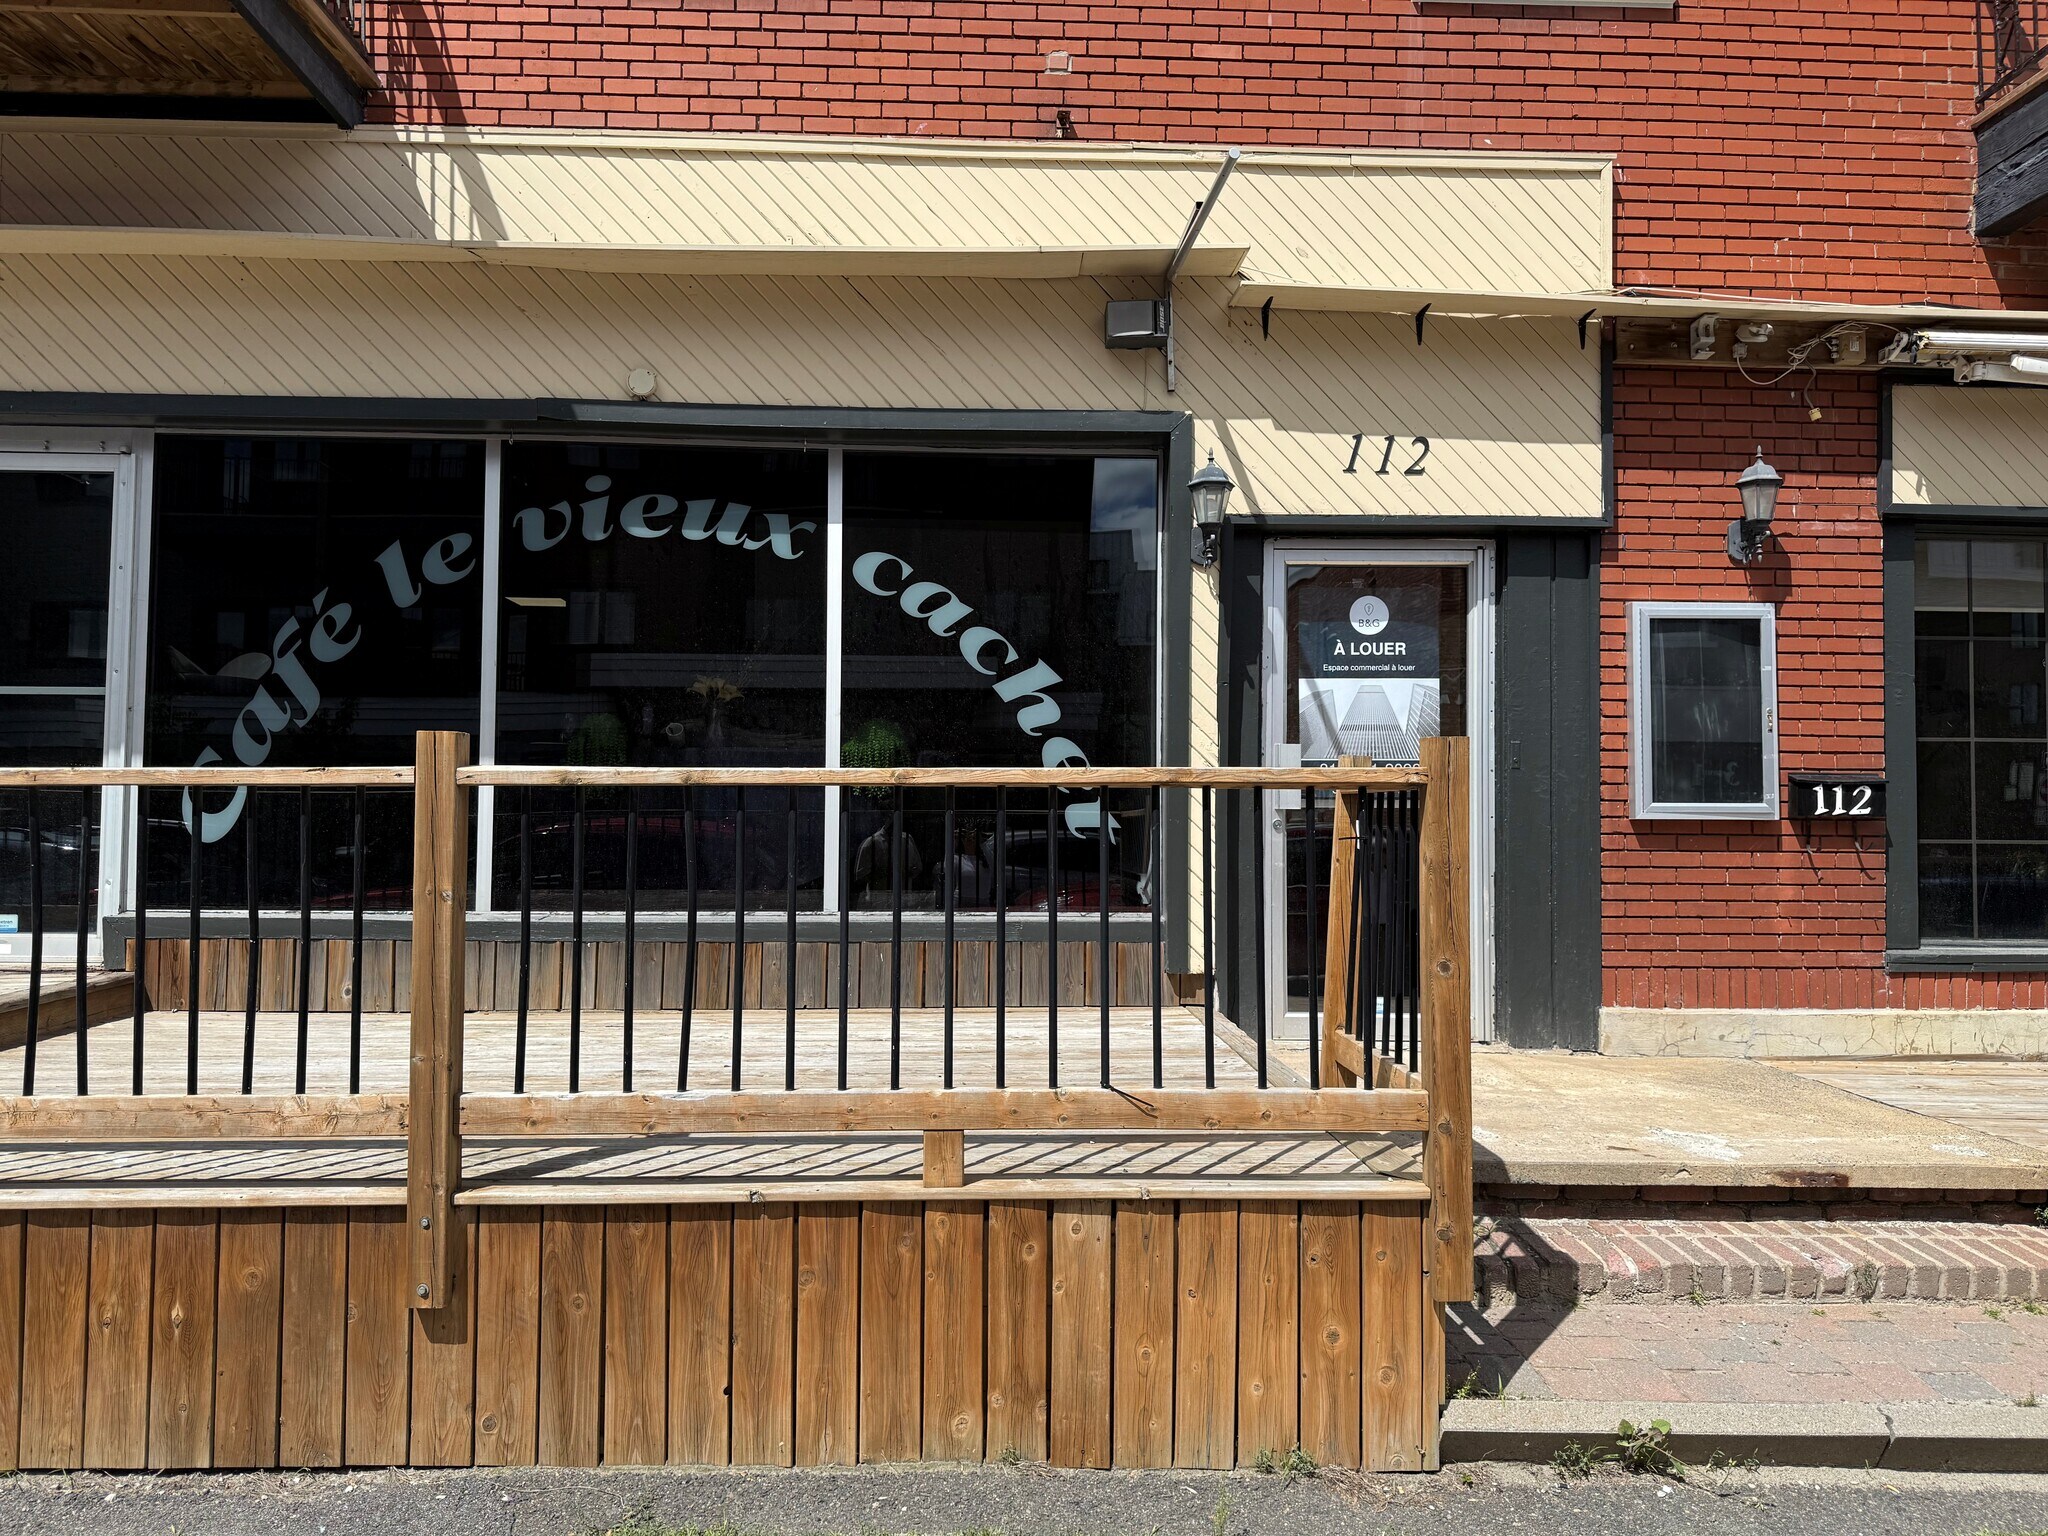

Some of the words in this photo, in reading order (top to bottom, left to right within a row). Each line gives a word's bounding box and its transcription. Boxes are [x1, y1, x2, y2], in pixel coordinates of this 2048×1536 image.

[1342, 433, 1430, 476] 112
[1358, 618, 1380, 628] B&G
[181, 587, 362, 843] Café
[374, 532, 477, 609] le
[512, 474, 818, 560] vieux
[852, 551, 1122, 846] cachet
[1333, 639, 1346, 656] À
[1350, 642, 1407, 656] LOUER
[1322, 663, 1349, 673] Espace
[1350, 663, 1390, 672] commercial
[1391, 663, 1397, 672] à
[1397, 663, 1416, 672] louer
[1812, 783, 1872, 816] 112
